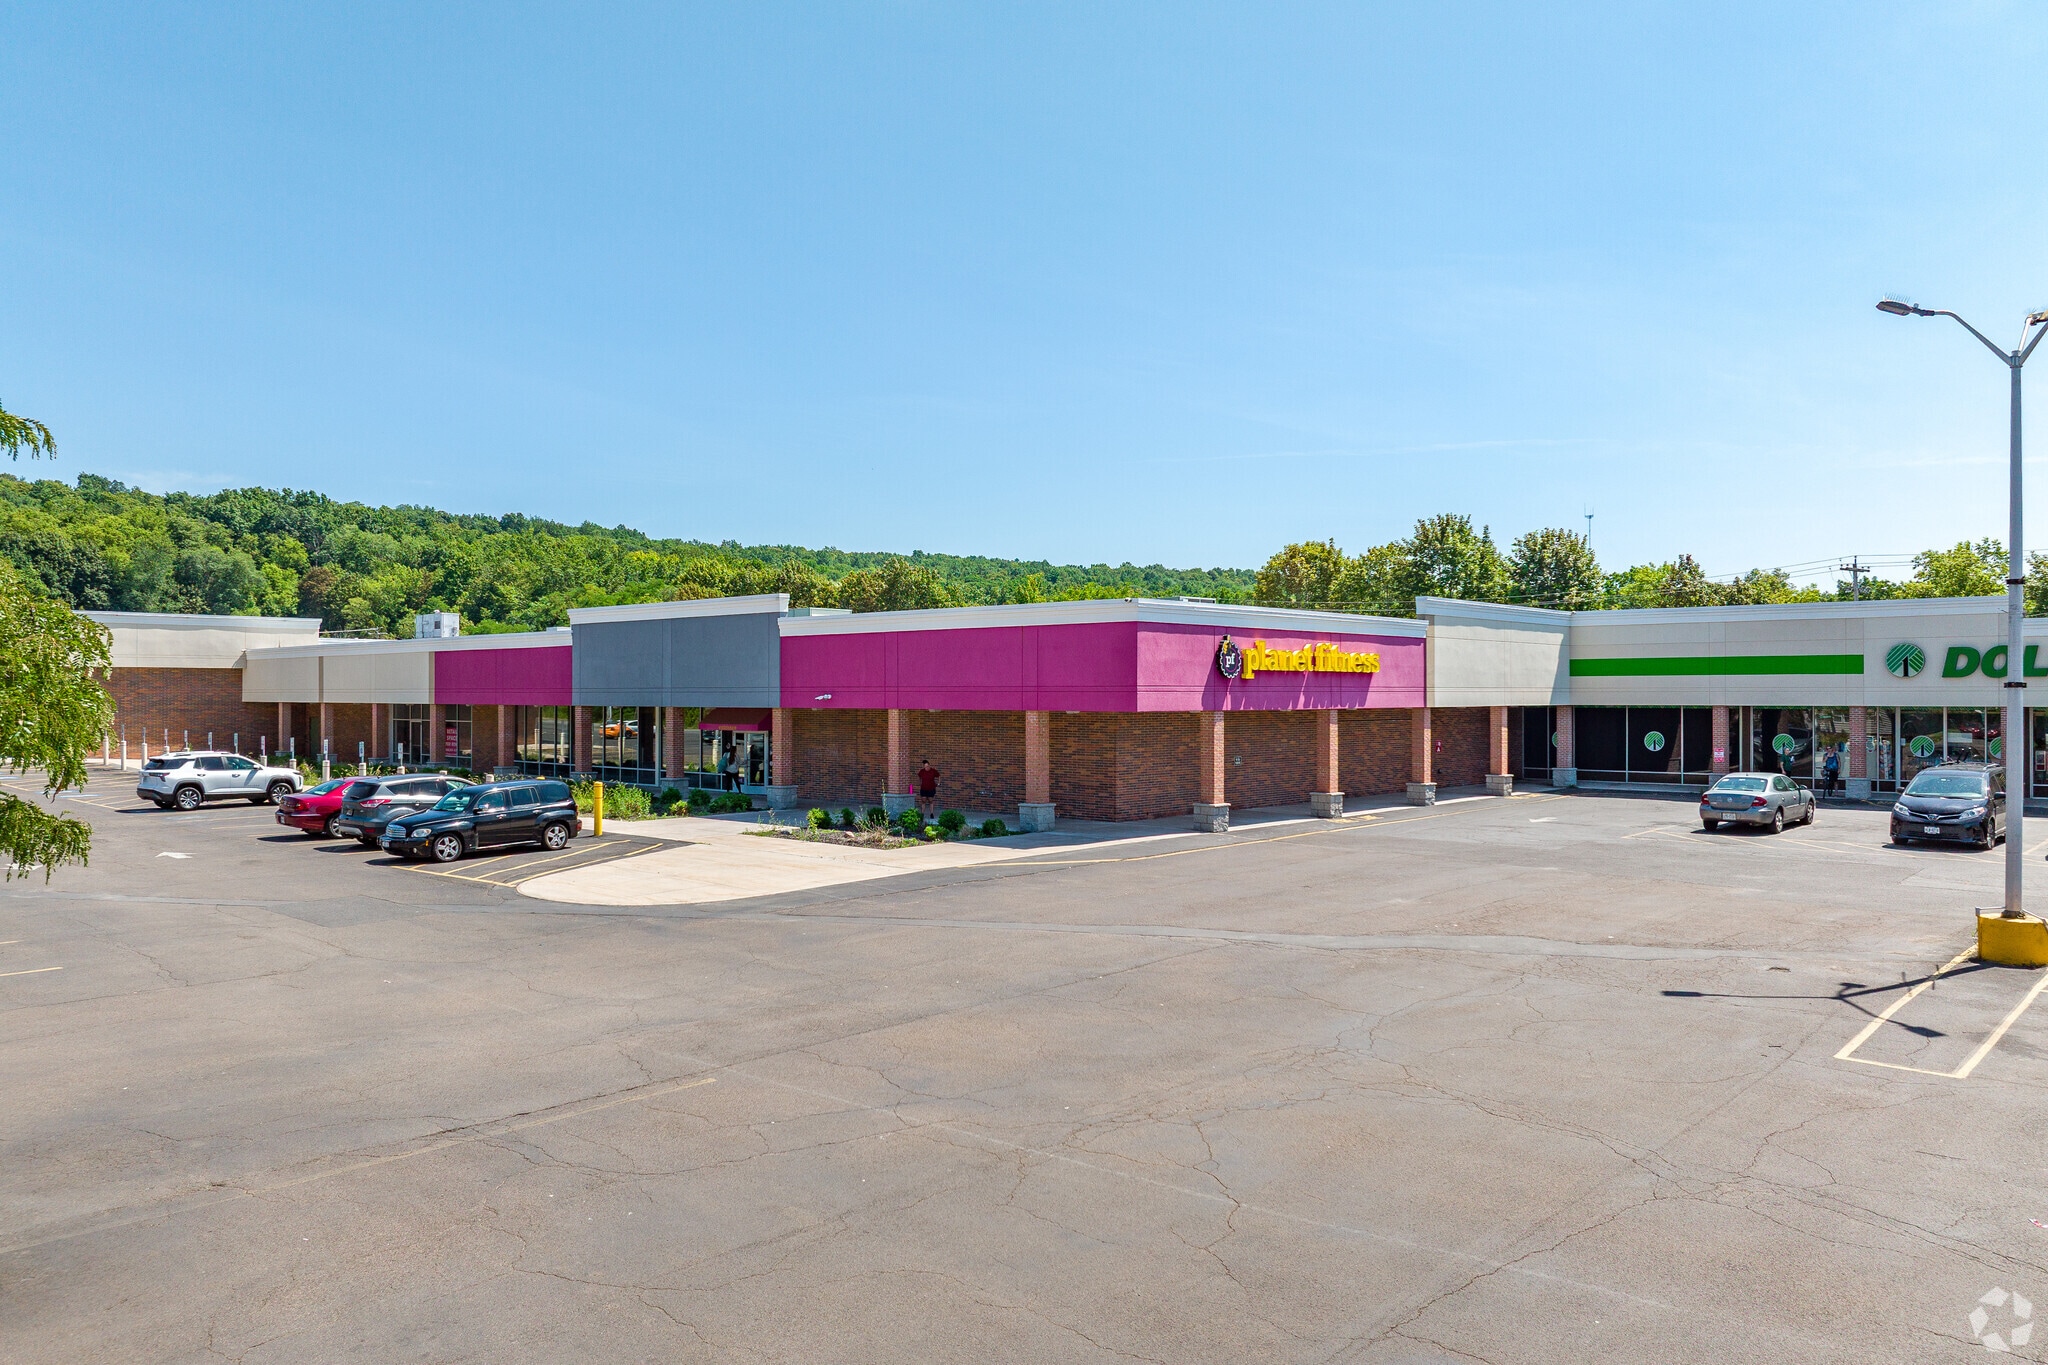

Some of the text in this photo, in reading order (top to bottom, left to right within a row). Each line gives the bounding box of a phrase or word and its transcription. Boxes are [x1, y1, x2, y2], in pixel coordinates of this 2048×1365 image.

[1225, 653, 1236, 668] pf
[1241, 640, 1380, 679] planet fitness
[1942, 645, 2048, 678] DOL
